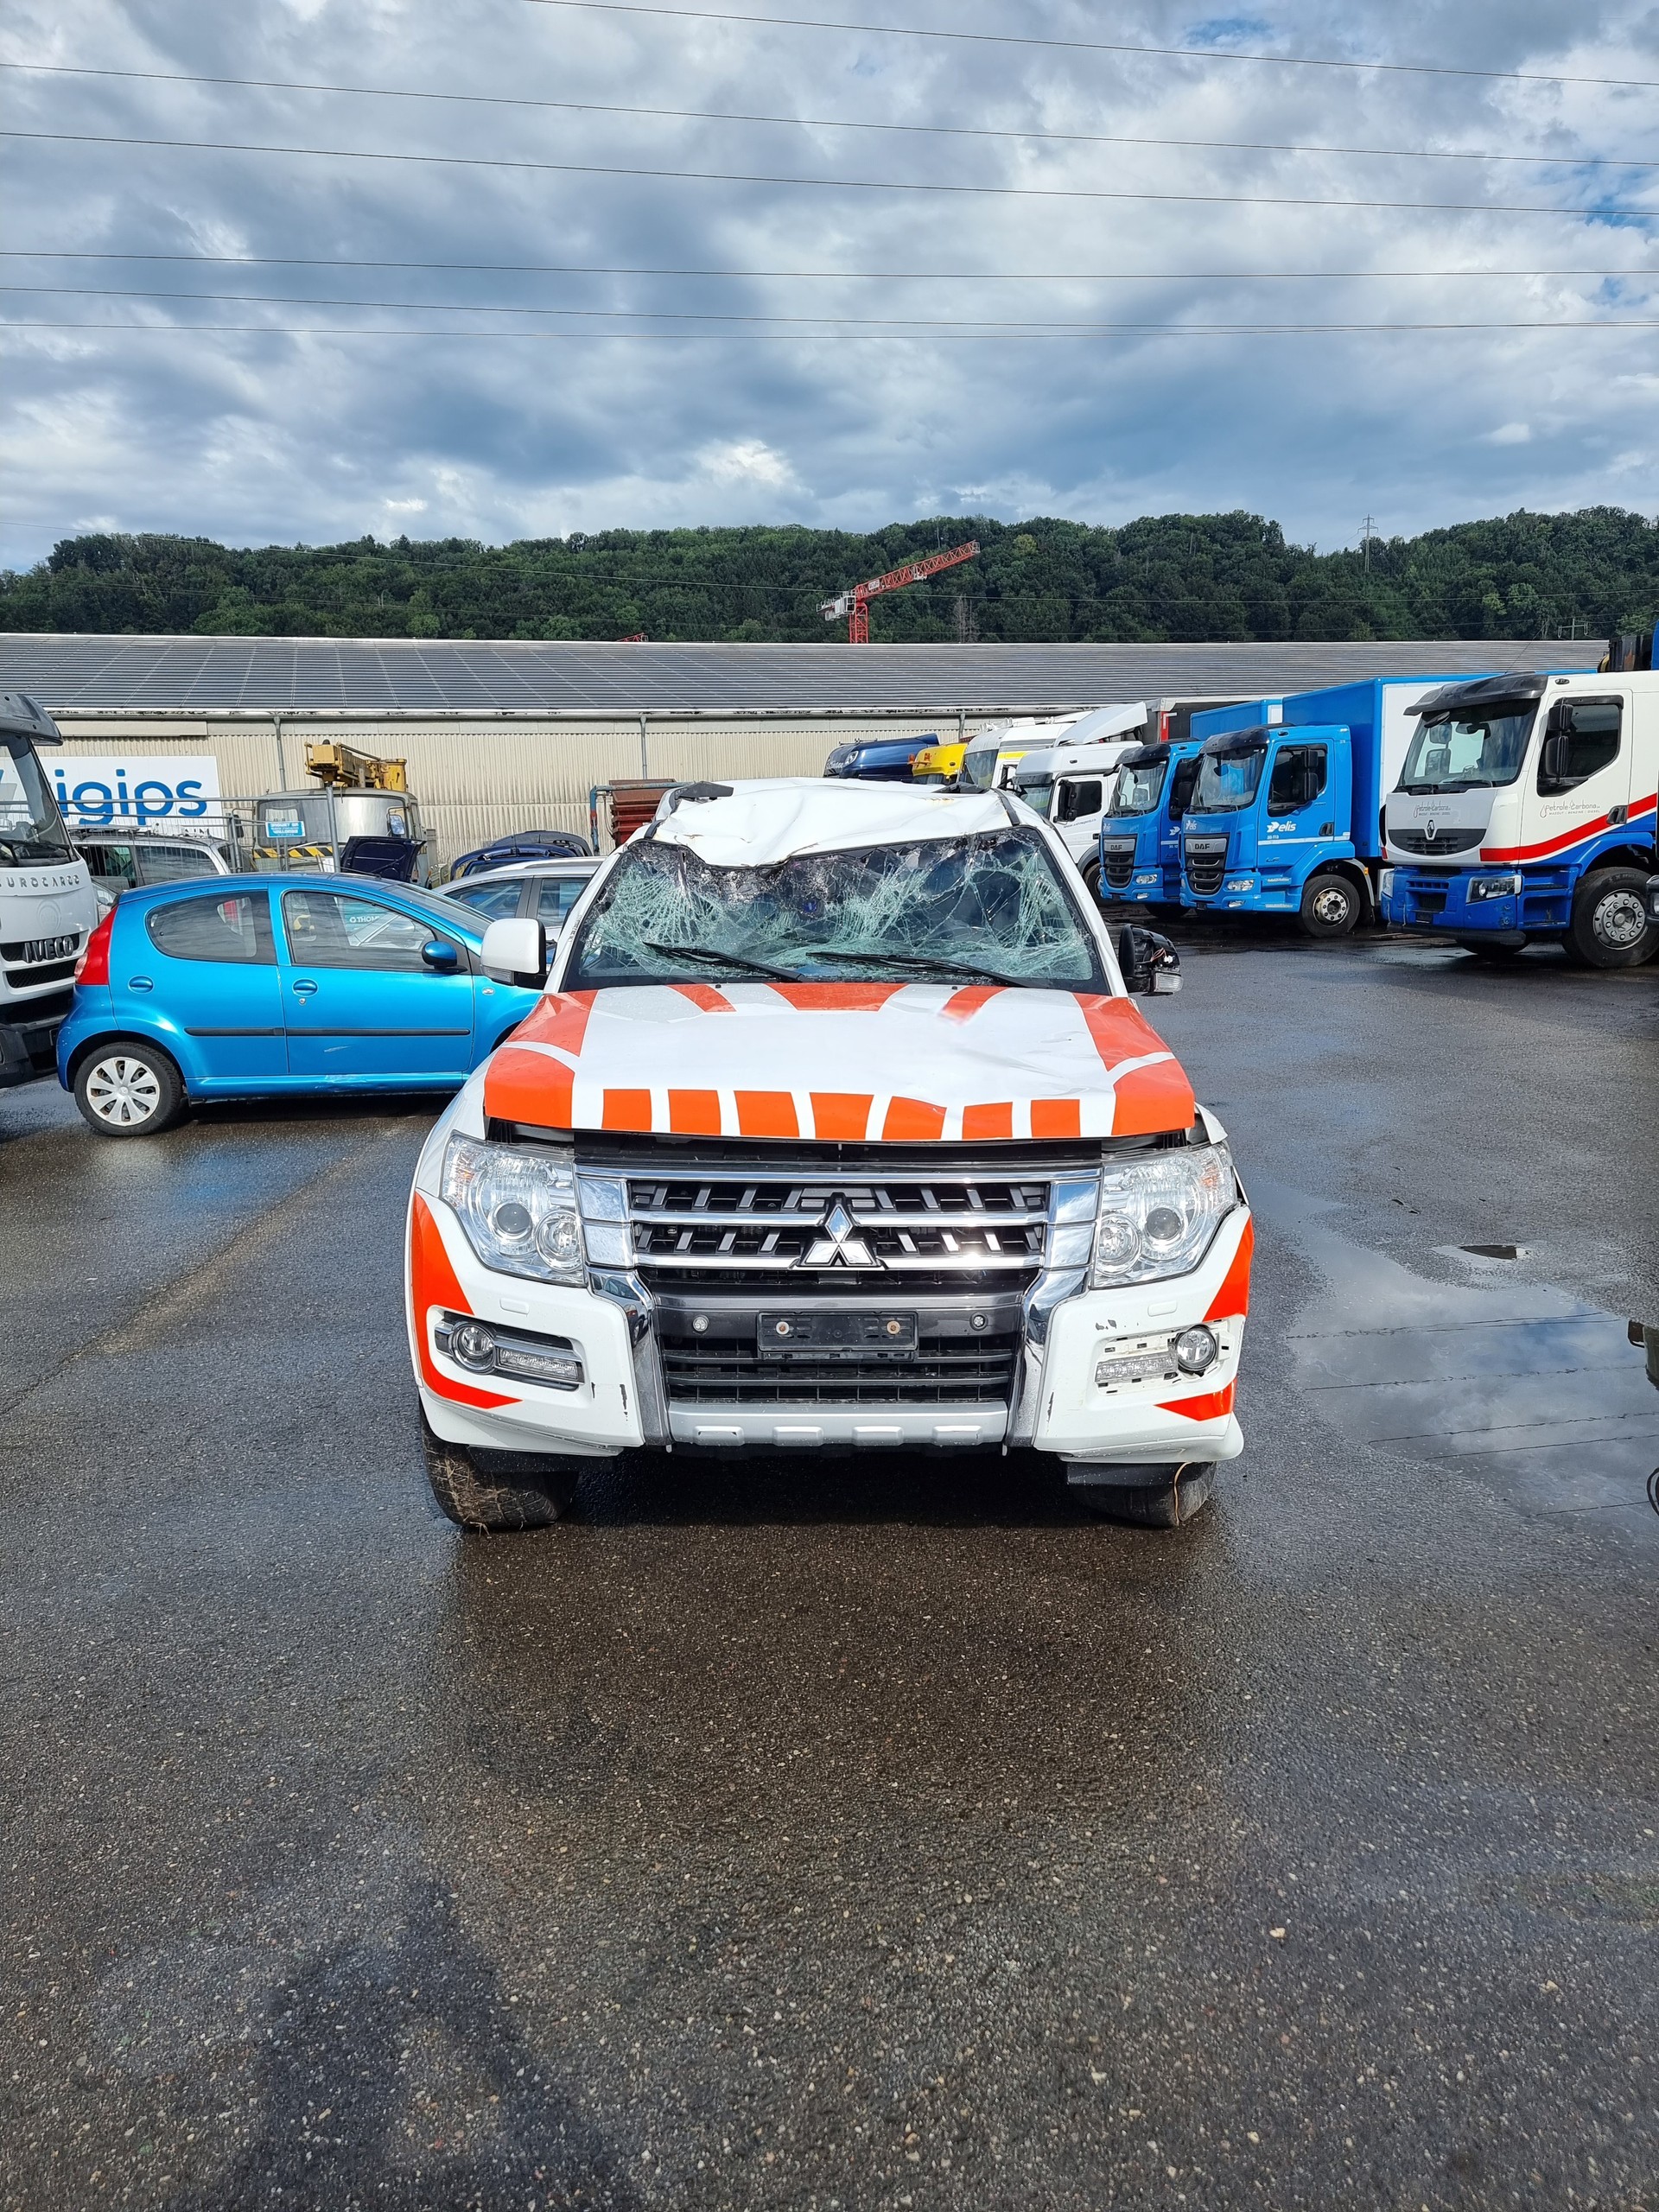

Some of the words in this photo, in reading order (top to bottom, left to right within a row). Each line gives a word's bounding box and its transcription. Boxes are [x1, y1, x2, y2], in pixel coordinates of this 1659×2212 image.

[54, 768, 208, 827] igips
[1279, 821, 1296, 832] elis
[0, 874, 80, 888] UROCARGO
[23, 936, 74, 963] IVECO
